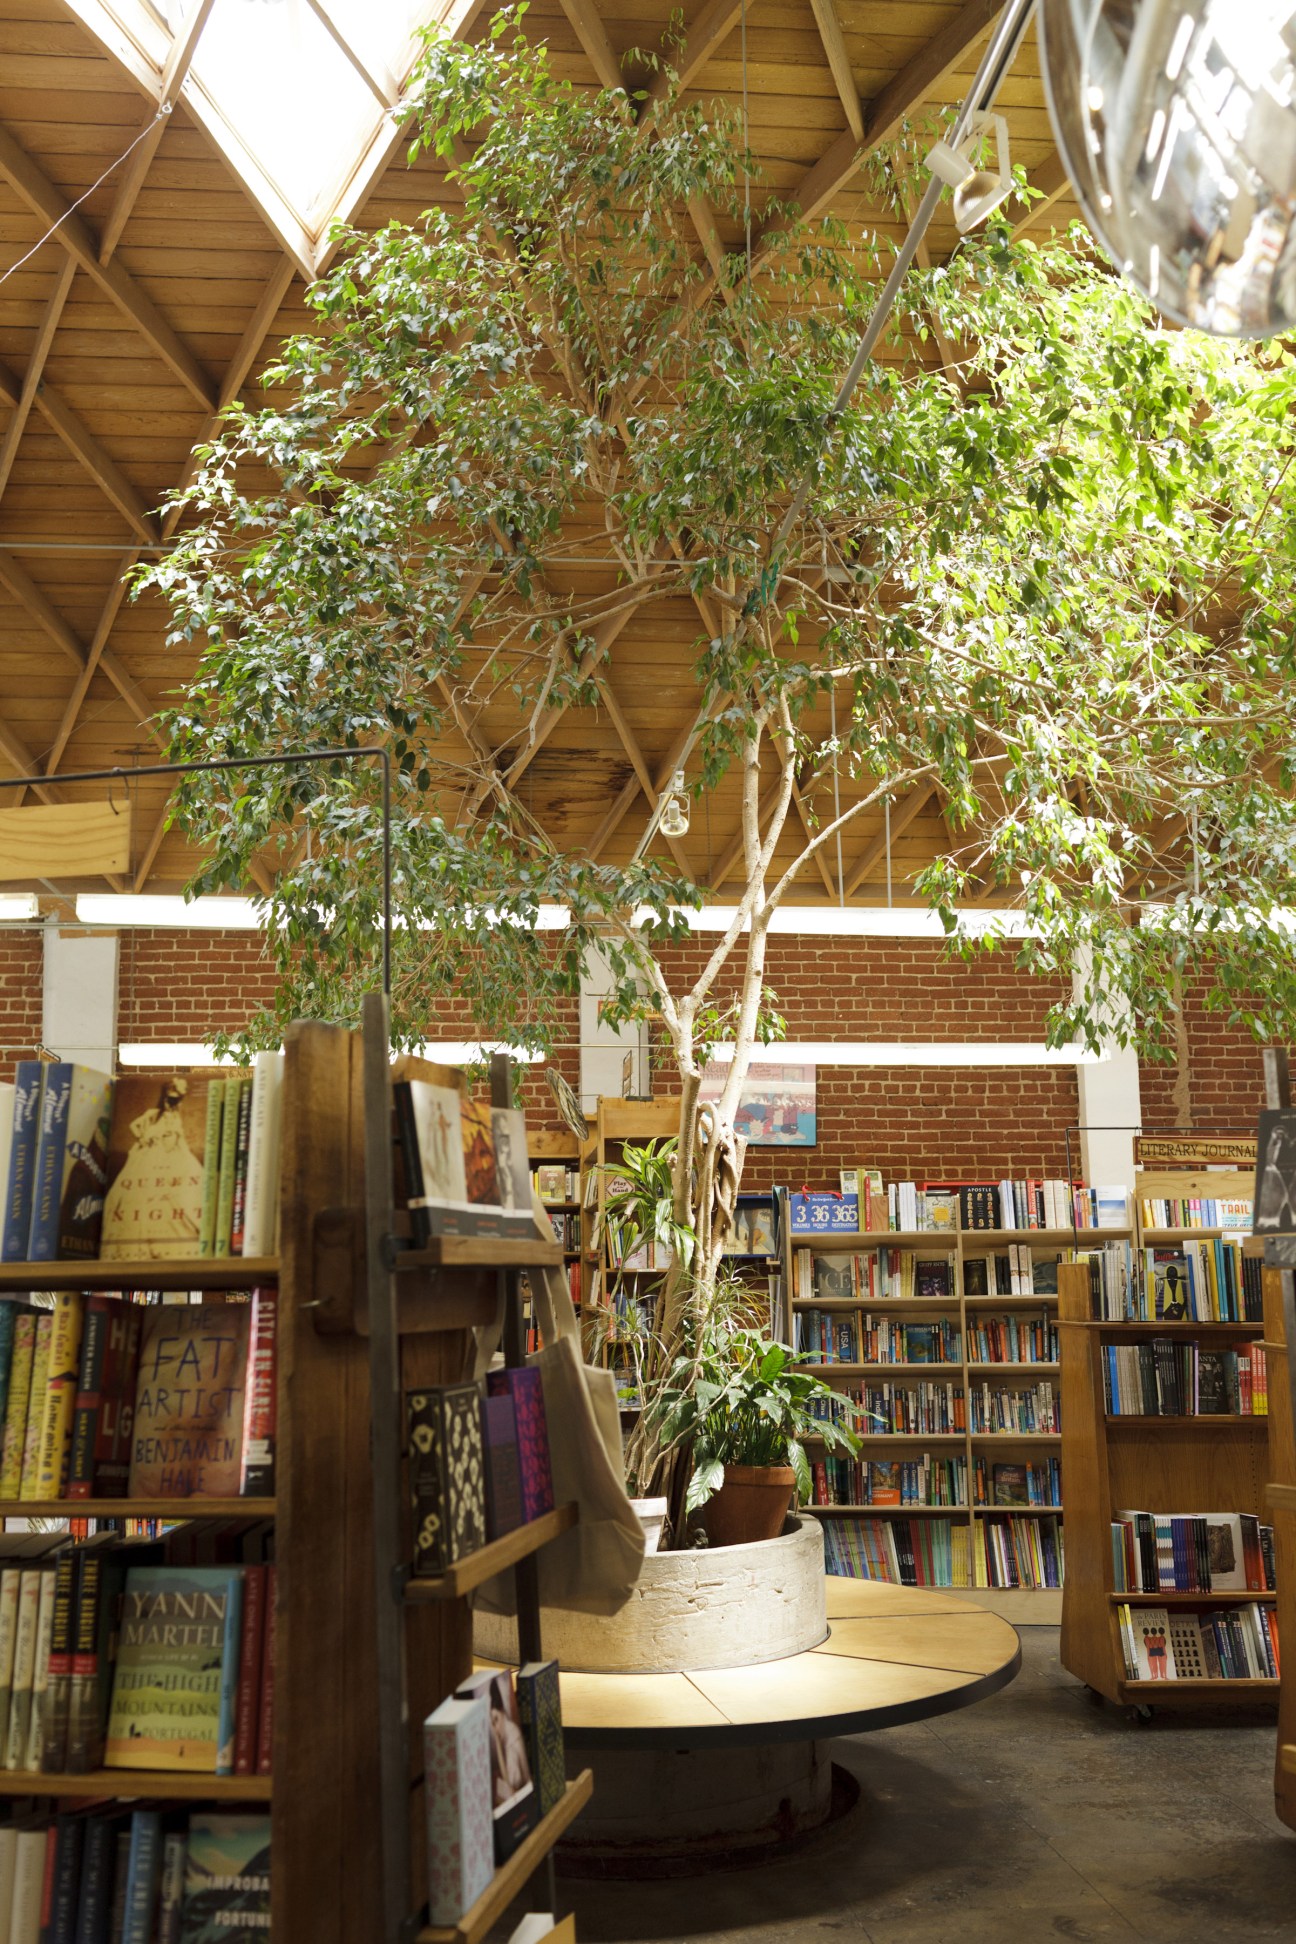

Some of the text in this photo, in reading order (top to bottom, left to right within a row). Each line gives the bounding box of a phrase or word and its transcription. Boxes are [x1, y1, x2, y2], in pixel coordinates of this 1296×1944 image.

[1140, 1143, 1257, 1158] LITERARY JOURNAL
[11, 1144, 27, 1220] ETHAN CANIN
[40, 1145, 57, 1222] ETHAN CANIN
[120, 1175, 201, 1190] QUEEN
[111, 1207, 203, 1223] NIGHT
[796, 1204, 859, 1223] 3 36 365
[1221, 1204, 1251, 1215] TRAIL
[818, 1271, 852, 1290] ICE
[172, 1307, 213, 1332] THE
[256, 1301, 275, 1338] CITY
[86, 1314, 98, 1358] JENNIFER
[840, 1331, 849, 1349] USA
[152, 1337, 236, 1382] FAT
[136, 1388, 242, 1419] ARTIST
[135, 1438, 236, 1464] BENJAMIN
[160, 1468, 207, 1493] HALE
[58, 1559, 73, 1594] THREE
[82, 1559, 99, 1594] THREE
[130, 1590, 228, 1621] YANN
[1143, 1612, 1167, 1620] PARIS
[244, 1574, 257, 1668] LATE ONE NIGHT
[1137, 1619, 1167, 1627] REVIEW
[125, 1623, 225, 1647] MARTEL
[118, 1672, 221, 1693] THE HIGH
[113, 1700, 219, 1718] MOUNTAINS
[238, 1680, 250, 1751] LEE MARTIN
